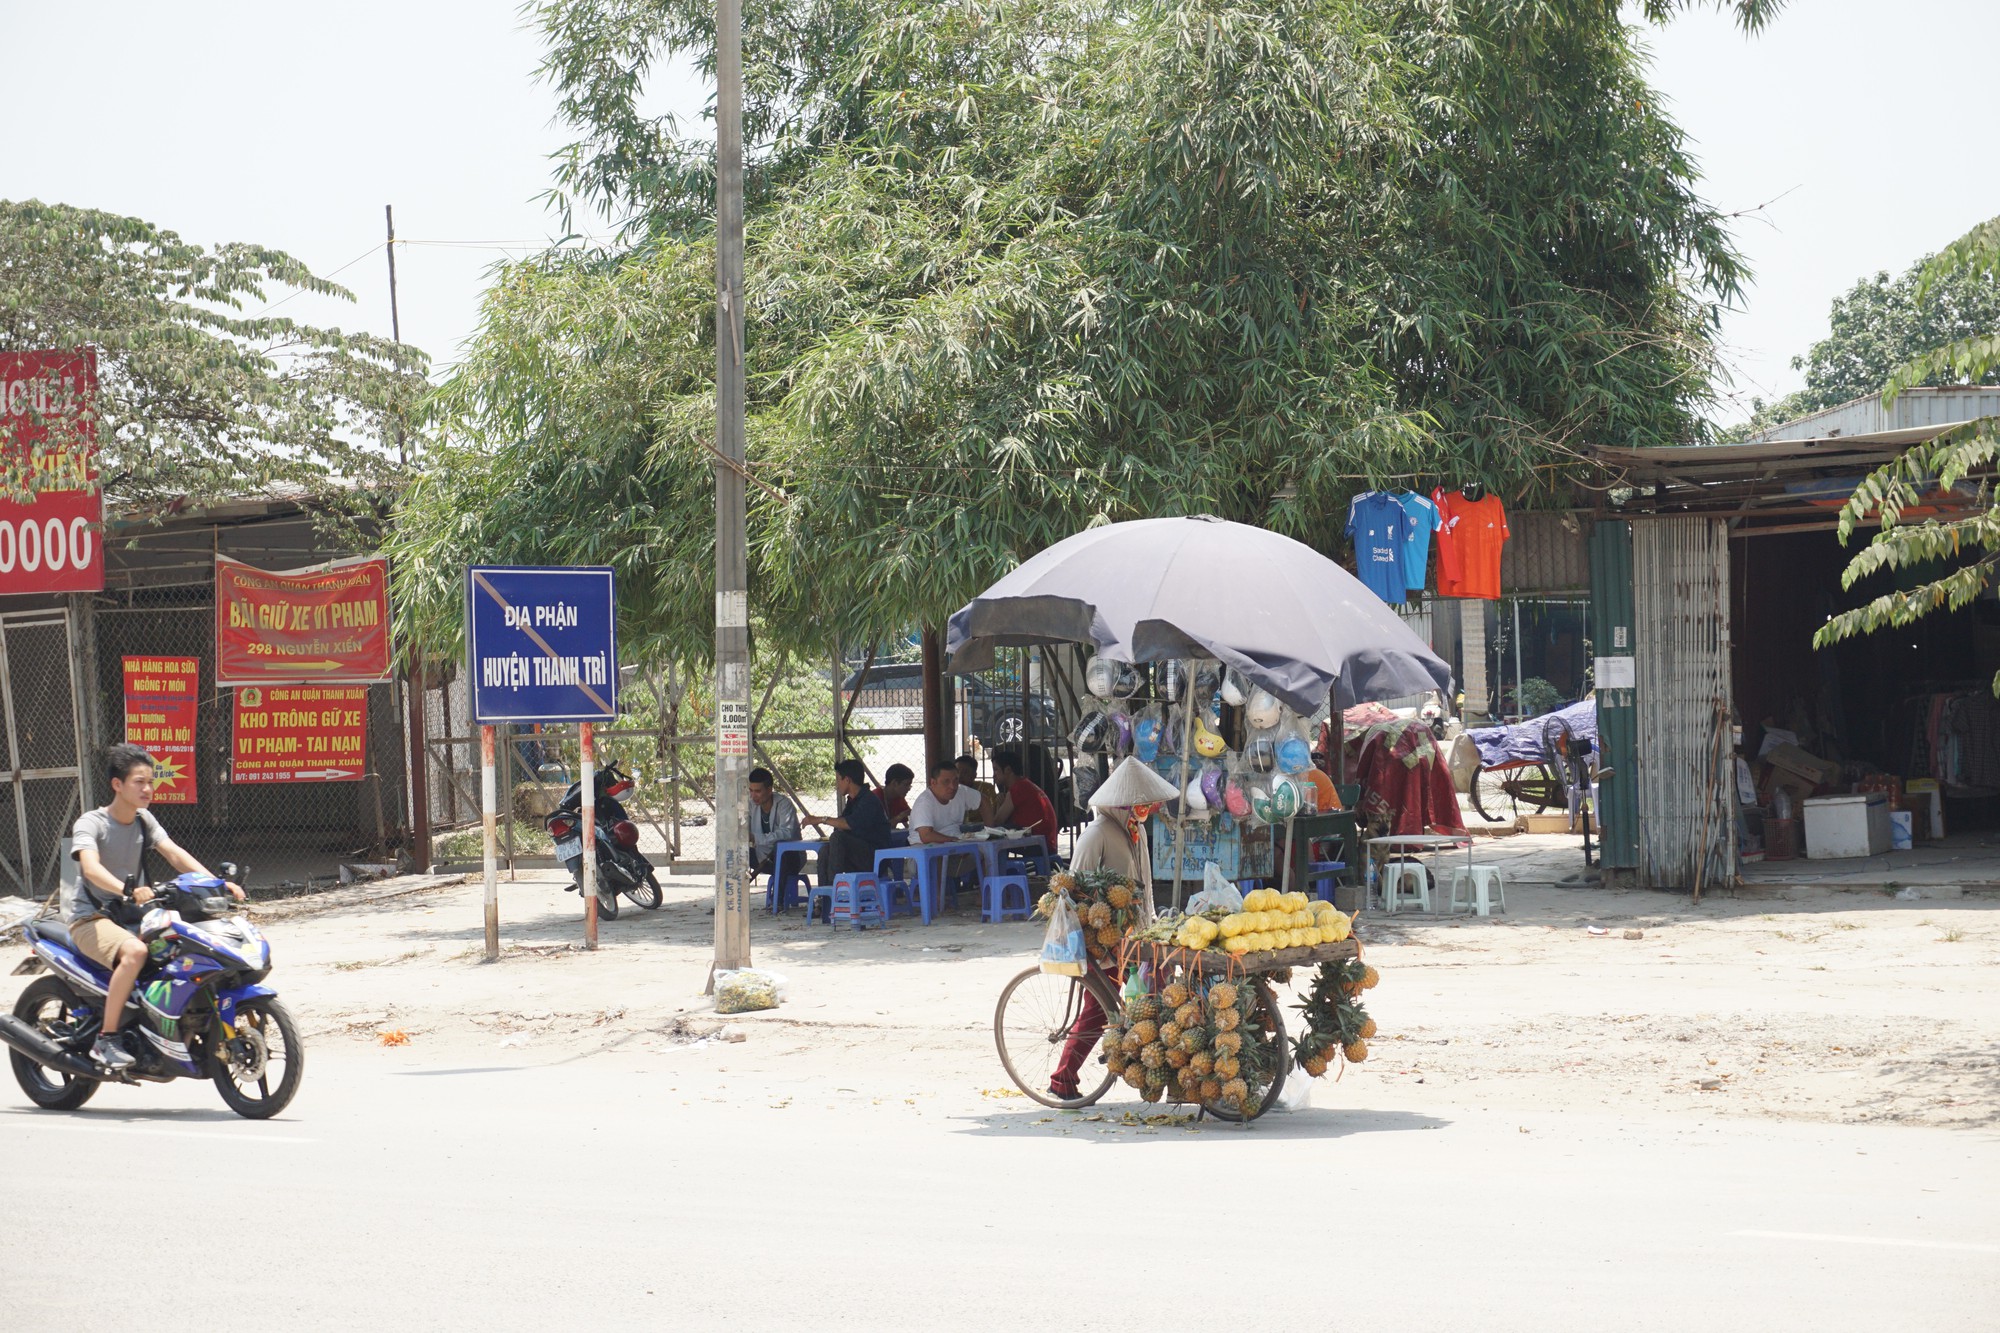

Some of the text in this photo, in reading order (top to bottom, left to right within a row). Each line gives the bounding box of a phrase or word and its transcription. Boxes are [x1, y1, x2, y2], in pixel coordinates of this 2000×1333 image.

[264, 579, 278, 589] AN
[230, 597, 378, 632] BÃI GIỮ XE VI PHẠM
[504, 601, 577, 630] ĐỊA PHẬN
[247, 636, 362, 656] 298 NGUYỄN XIỂN
[125, 658, 140, 673] NHÀ
[142, 659, 163, 673] HÀNG
[165, 661, 179, 674] HOA
[483, 650, 607, 692] HUYỆN THANH TRÌ
[162, 680, 167, 691] 7
[168, 678, 186, 692] MÓN
[270, 687, 365, 702] CÔNG AN QUẬN THANH XUÂN
[721, 704, 733, 712] CHO
[240, 712, 268, 729] KHO
[272, 708, 317, 727] TRÔNG
[343, 711, 361, 726] XE
[128, 726, 190, 744] BIA HƠI HÀ NỘI
[239, 738, 252, 754] VI
[306, 736, 327, 752] TAI
[332, 736, 361, 755] NẠN
[236, 760, 261, 769] CÔNG
[279, 759, 304, 769] QUẬN
[307, 759, 336, 767] THANH
[338, 757, 363, 766] XUÂN
[248, 773, 260, 781] 091
[262, 772, 274, 780] 243
[275, 772, 291, 780] 1955
